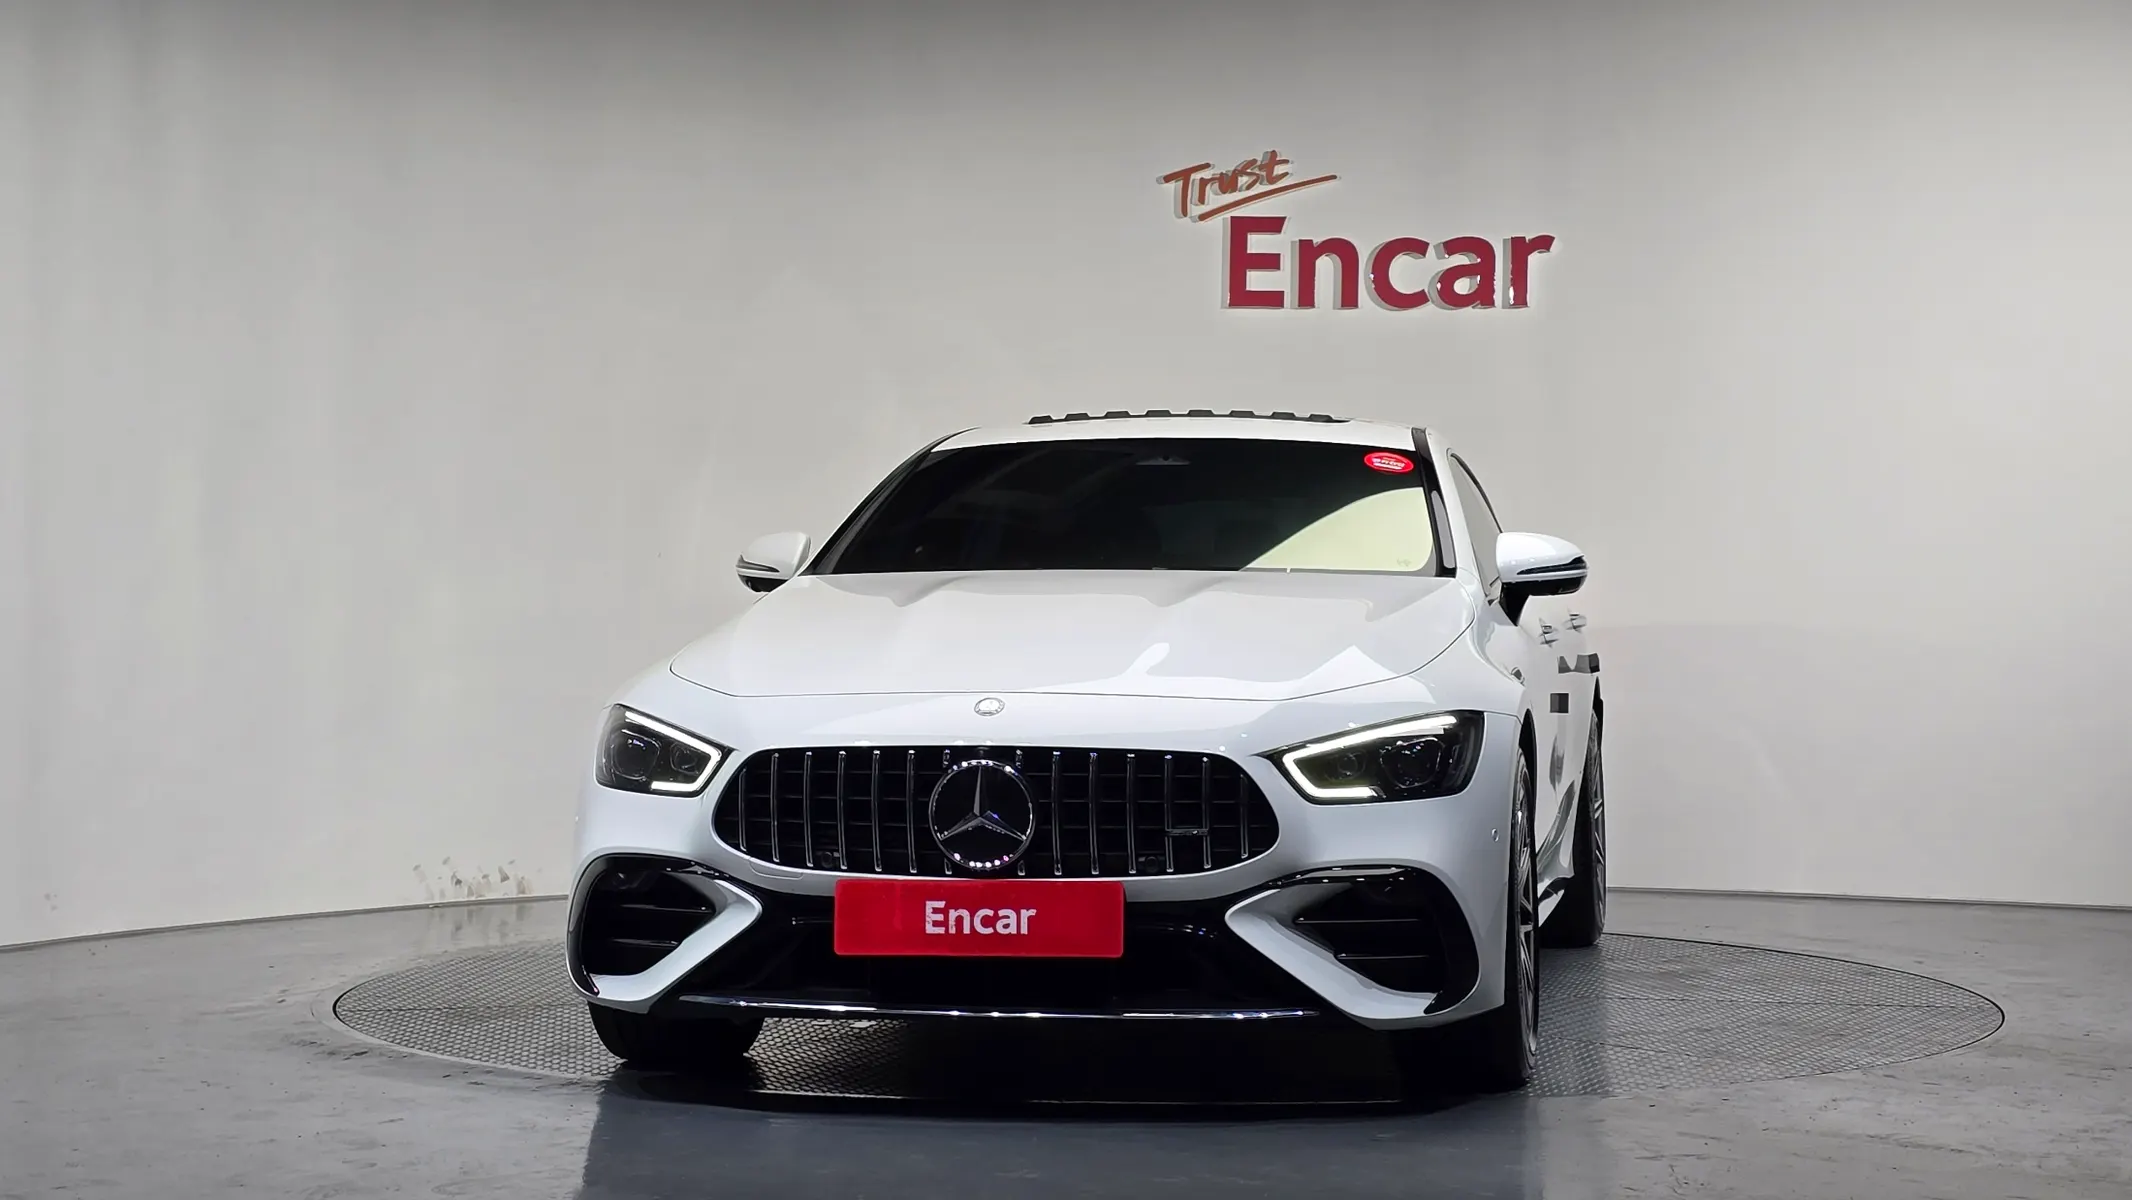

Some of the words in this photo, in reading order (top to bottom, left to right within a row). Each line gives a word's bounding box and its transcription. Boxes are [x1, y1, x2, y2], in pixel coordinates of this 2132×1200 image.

[1162, 150, 1291, 218] Trust
[1227, 215, 1556, 309] Encar
[925, 900, 1037, 935] Encar
